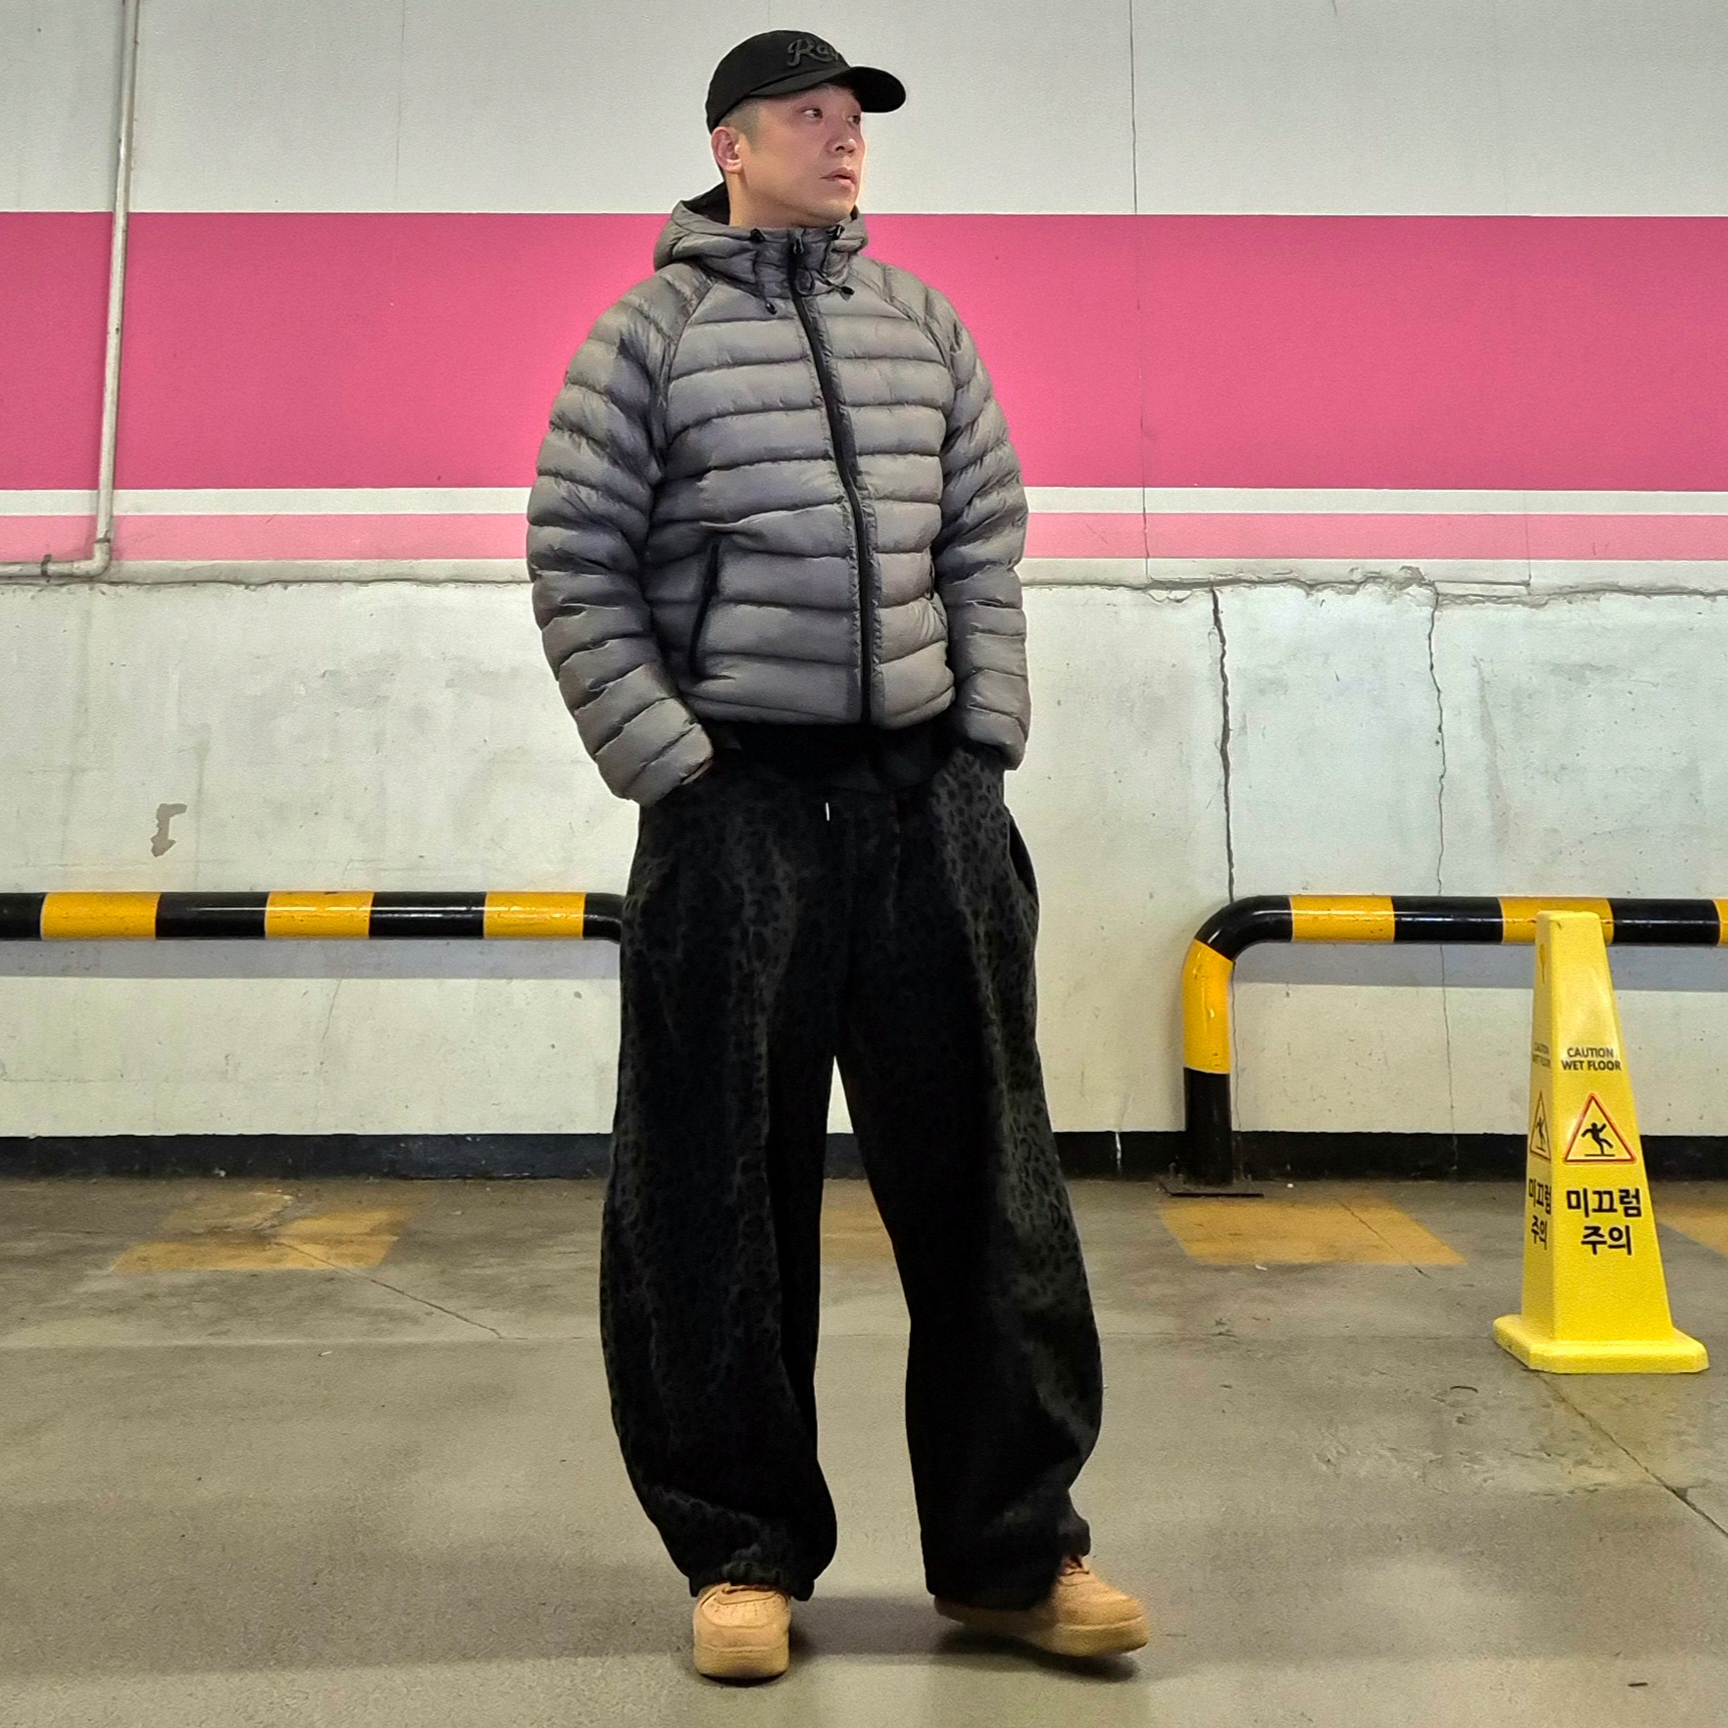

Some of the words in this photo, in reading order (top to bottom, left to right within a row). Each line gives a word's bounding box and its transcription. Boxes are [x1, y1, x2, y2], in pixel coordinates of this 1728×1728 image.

[1566, 1047, 1614, 1058] CAUTION
[1561, 1060, 1585, 1071] WET
[1588, 1060, 1622, 1071] FLOOR
[1566, 1187, 1642, 1218] 미끄럼
[1580, 1225, 1632, 1256] 주의
